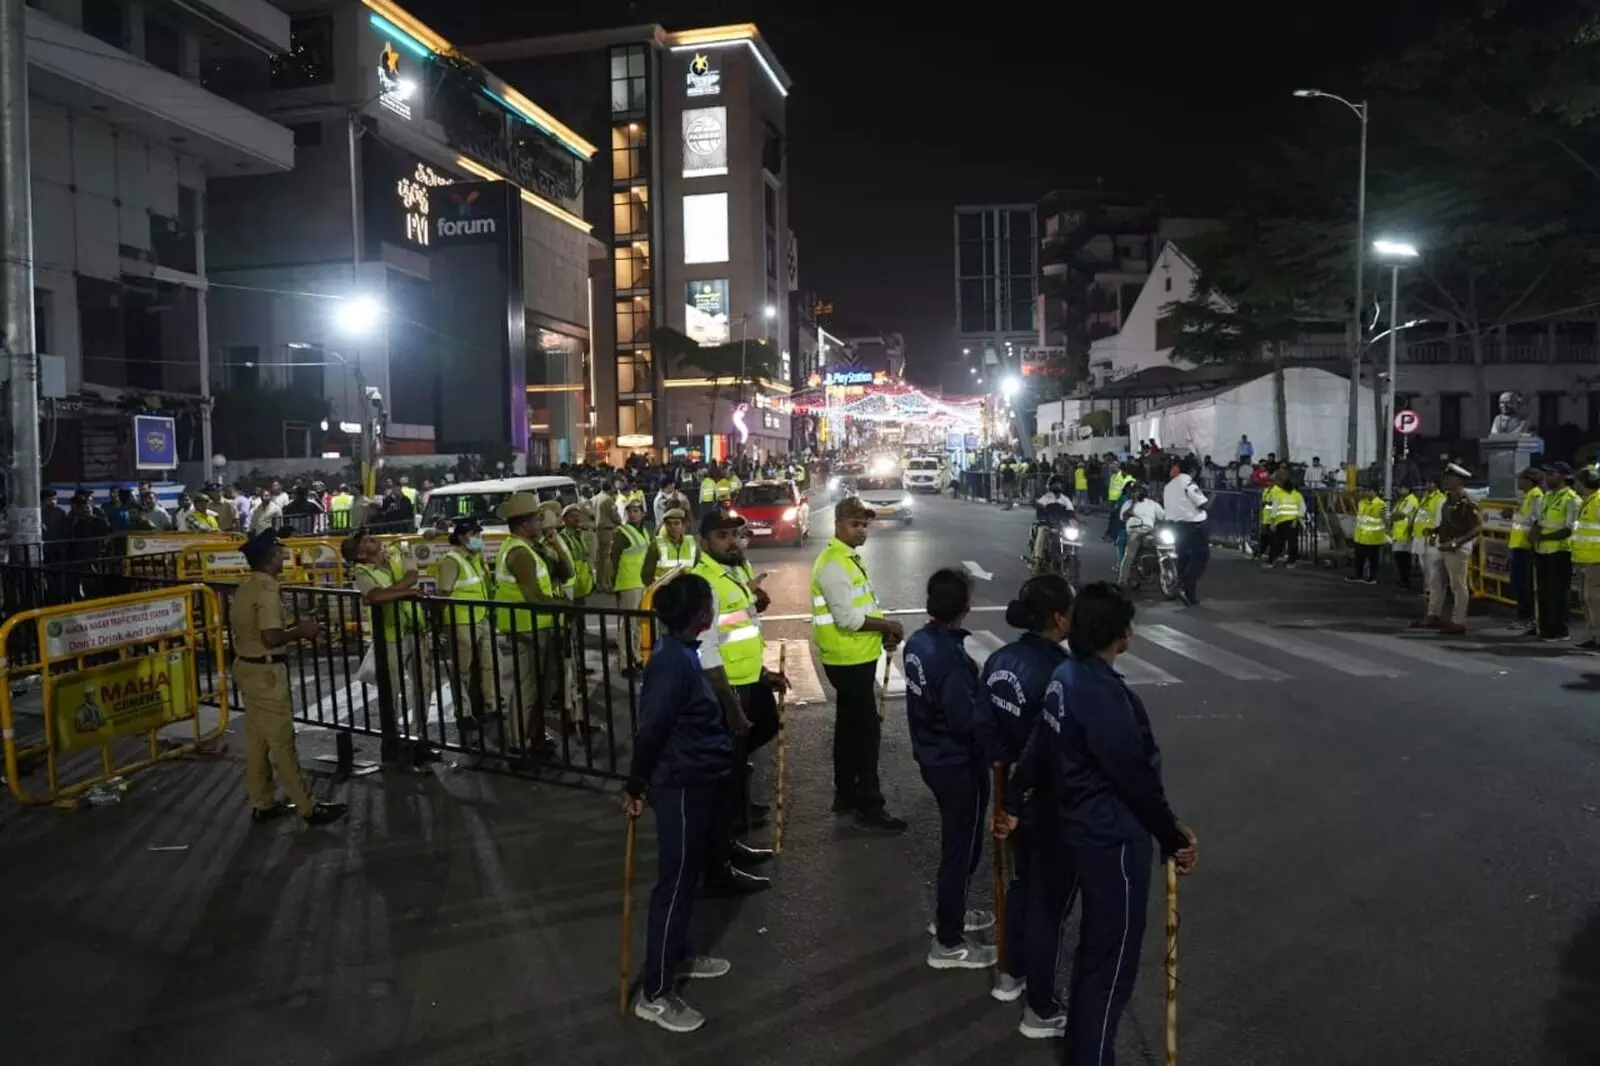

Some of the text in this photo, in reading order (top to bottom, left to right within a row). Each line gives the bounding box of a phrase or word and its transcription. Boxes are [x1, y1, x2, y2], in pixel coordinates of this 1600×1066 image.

[437, 217, 496, 237] forum
[833, 371, 873, 385] PlayStation
[1401, 413, 1415, 430] P
[98, 630, 124, 646] Drink
[125, 626, 144, 640] And
[145, 623, 169, 637] Drive
[101, 671, 171, 703] MAHA
